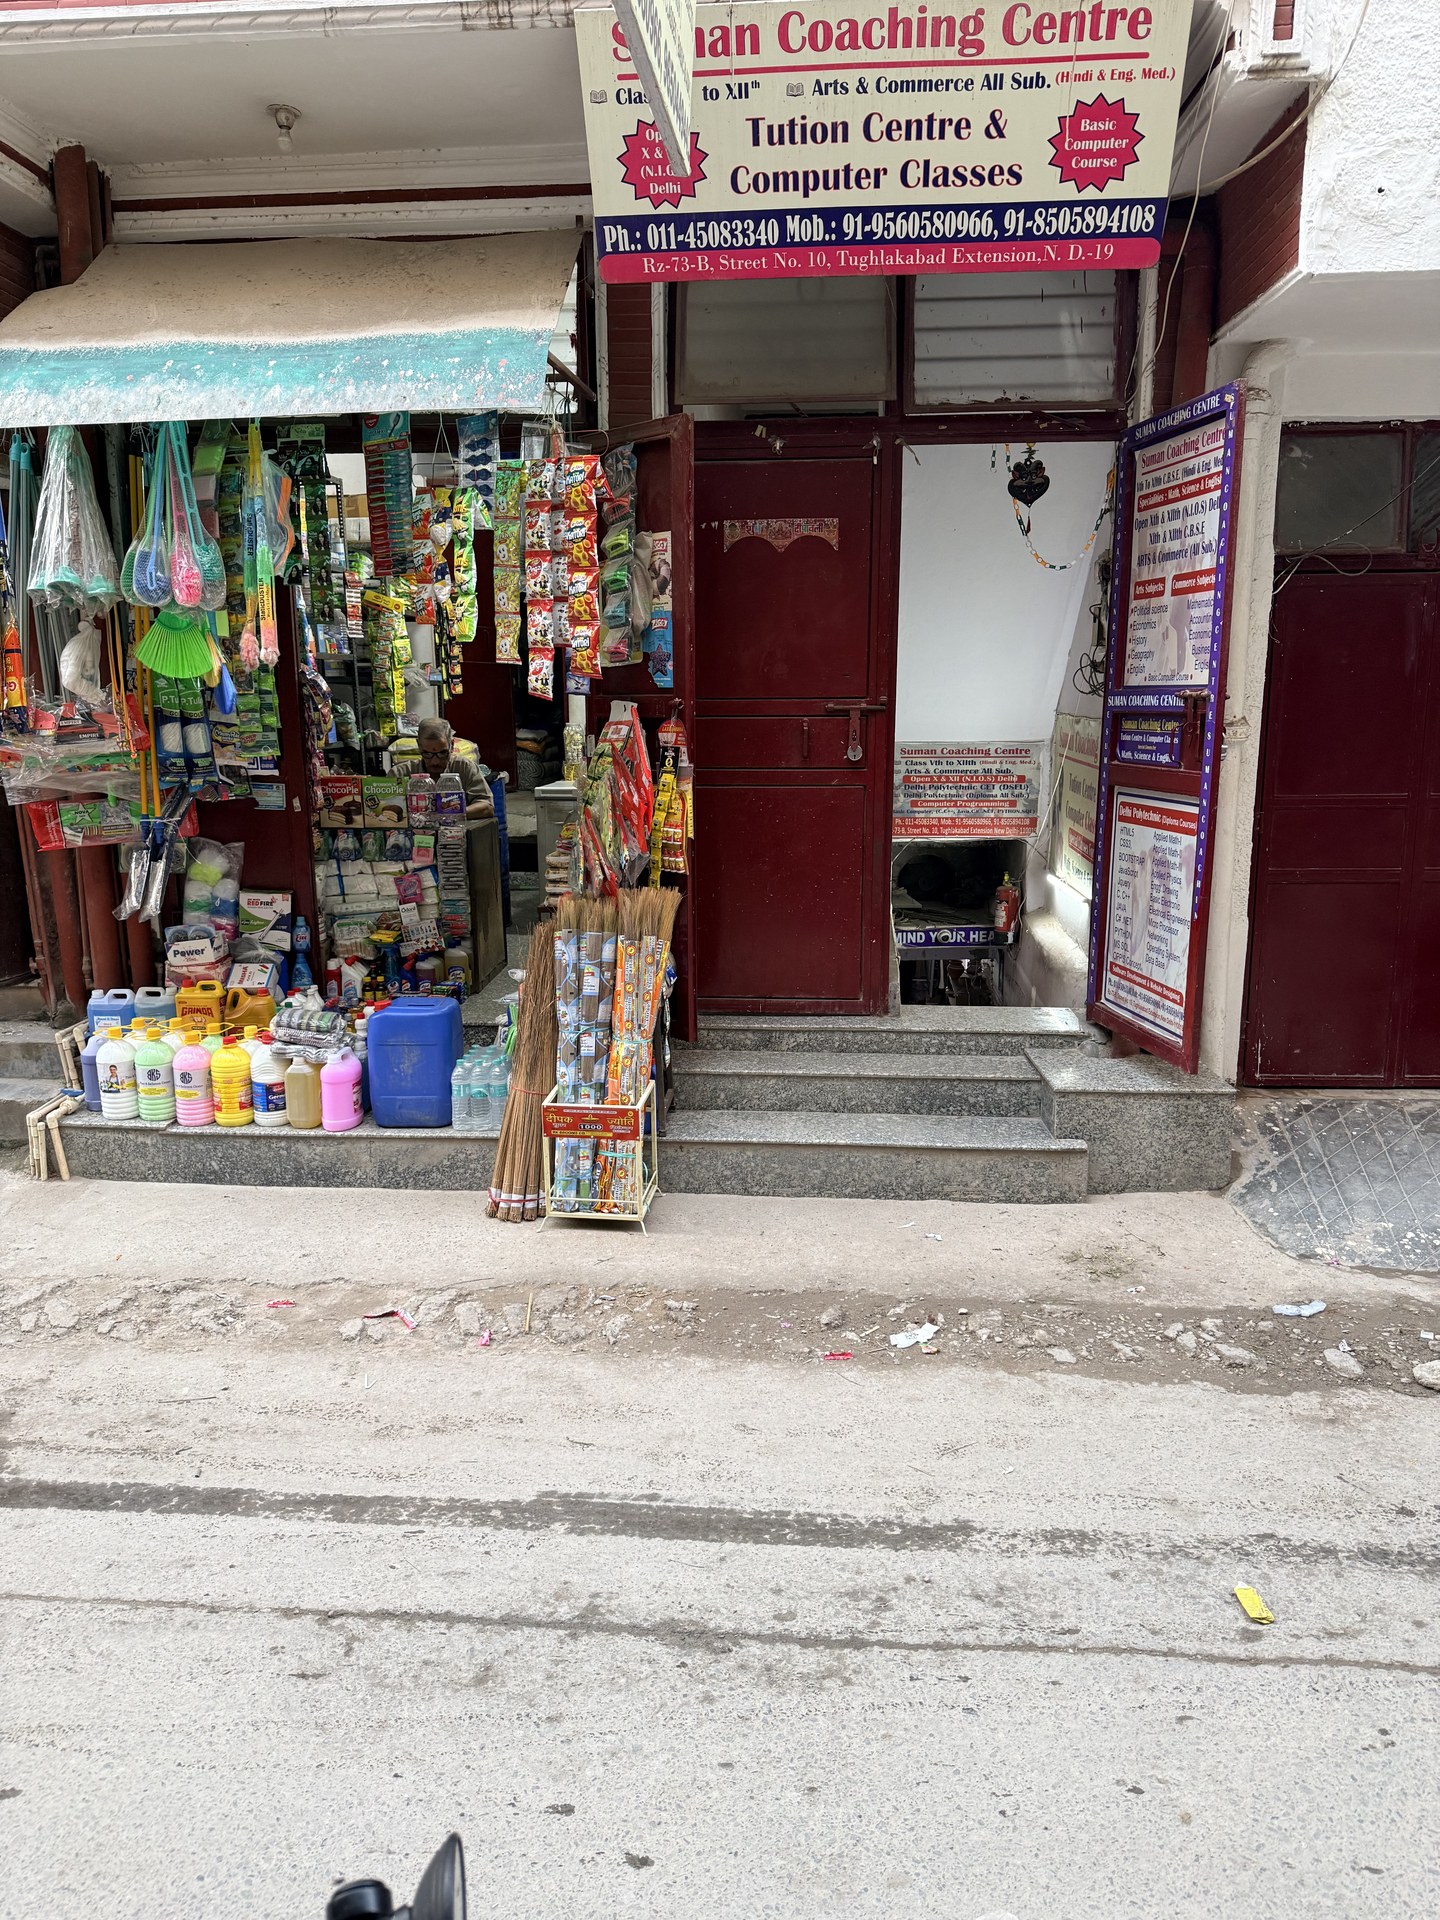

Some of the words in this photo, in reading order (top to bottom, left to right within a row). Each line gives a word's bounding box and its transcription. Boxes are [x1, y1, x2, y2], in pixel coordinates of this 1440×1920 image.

[612, 21, 760, 62] San
[777, 5, 985, 57] Coaching
[1002, 2, 1152, 47] Centre
[1055, 69, 1093, 85] (Hindi
[1097, 67, 1107, 82] &
[1110, 68, 1137, 83] Eng.
[1141, 66, 1176, 81] Med.)
[812, 78, 849, 97] Arts
[855, 77, 869, 94] &
[875, 75, 974, 94] Commerce
[980, 73, 1004, 91] All
[1010, 71, 1051, 90] Sub.
[615, 88, 650, 105] Cla
[702, 83, 719, 101] to
[745, 115, 849, 148] Tution
[862, 111, 971, 144] Centre
[984, 108, 1008, 140] &
[1080, 118, 1117, 131] Basic
[645, 128, 663, 143] Op
[1064, 136, 1129, 152] Computer
[641, 147, 651, 159] X
[654, 146, 663, 159] &
[1071, 156, 1117, 169] Course
[730, 162, 887, 198] Computer
[900, 159, 1023, 189] Classes
[650, 182, 681, 194] Delhi
[603, 224, 642, 252] Ph.:
[647, 218, 780, 250] 011-45083340
[786, 213, 837, 243] Mob.:
[843, 210, 999, 242] 91-9560580966,
[1004, 204, 1156, 237] 91-8505894108
[642, 255, 714, 274] Rz-73-B,
[719, 254, 768, 271] Street
[773, 252, 801, 269] No.
[807, 251, 831, 270] 10,
[836, 248, 946, 272] Tughlakabad
[1067, 243, 1114, 261] D.-19
[1157, 407, 1192, 431] COACHING
[1192, 393, 1221, 416] CENTRE
[1142, 450, 1165, 469] Suman
[1167, 435, 1200, 460] Coaching
[1181, 482, 1200, 496] Science
[1135, 517, 1148, 533] Open
[1149, 514, 1159, 527] Xth
[1182, 500, 1207, 521] (N.I.O.S)
[1183, 521, 1206, 539] C.B.S.E
[1136, 552, 1151, 568] ARTS
[1158, 546, 1188, 564] Commerce
[1135, 585, 1144, 595] Arts
[1172, 577, 1196, 590] Commerce
[1134, 605, 1150, 616] Political
[1151, 603, 1168, 615] science
[1132, 620, 1156, 631] Economics
[1131, 635, 1147, 646] History
[1130, 649, 1154, 661] Geography
[1129, 663, 1146, 677] English
[1148, 673, 1158, 682] Basic
[1159, 672, 1176, 683] Computer
[1176, 671, 1189, 681] Course
[1108, 695, 1128, 706] SUMAN
[1128, 694, 1160, 707] COACHING
[1121, 717, 1138, 730] Suman
[1138, 717, 1161, 733] Coaching
[900, 747, 937, 756] Suman
[940, 747, 991, 757] Coaching
[994, 746, 1031, 756] Centre
[1121, 749, 1133, 760] Math,
[1134, 751, 1151, 761] Science
[980, 767, 992, 775] All
[994, 767, 1014, 775] Sub.
[910, 775, 931, 783] Open
[962, 775, 995, 783] (N.I.O.S)
[928, 784, 978, 792] Polytechnic
[998, 783, 1029, 791] (DSEU)
[965, 792, 998, 800] (Diploma
[917, 800, 954, 808] Computer
[956, 800, 1010, 808] Programming
[1119, 804, 1132, 817] Delhi
[1132, 807, 1162, 824] Polytechnic
[1162, 815, 1179, 827] (Diploma
[1179, 818, 1198, 832] Courses)
[907, 826, 922, 835] Street
[922, 826, 931, 835] No.
[940, 826, 970, 836] Tughlakabad
[970, 826, 994, 835] Extension
[994, 826, 1005, 835] New
[1119, 826, 1135, 838] HTML5
[1152, 830, 1168, 843] Applied
[1152, 843, 1168, 856] Applied
[1151, 856, 1169, 869] Applied
[1117, 865, 1139, 880] JavaScript
[1150, 868, 1166, 881] Applied
[1166, 872, 1182, 885] Physics
[1162, 883, 1179, 900] Drawing
[1148, 904, 1166, 919] Electrical
[1166, 911, 1191, 930] Engineering
[1159, 920, 1180, 936] Processor
[1147, 929, 1169, 948] Networking
[173, 947, 206, 958] Power
[1146, 941, 1166, 959] Operating
[181, 1006, 214, 1018] GAINDA
[545, 1112, 574, 1124] दीपक
